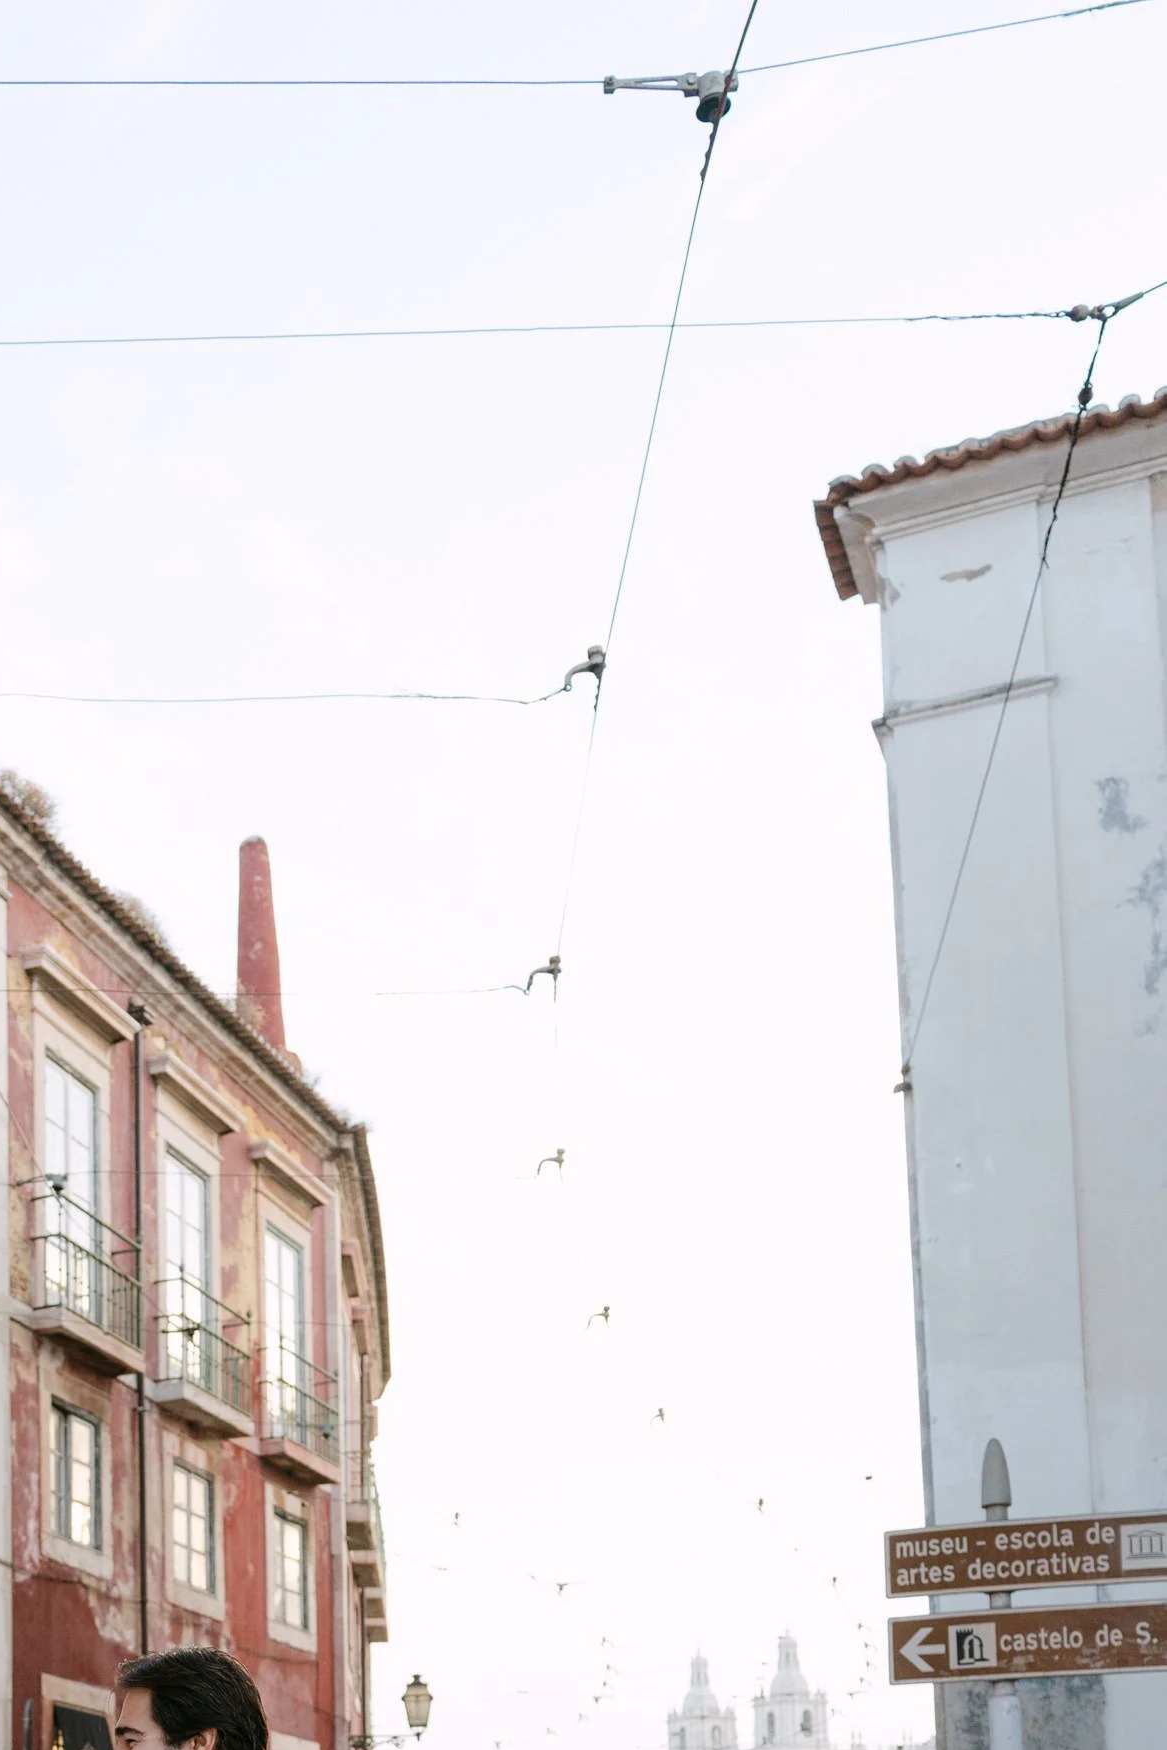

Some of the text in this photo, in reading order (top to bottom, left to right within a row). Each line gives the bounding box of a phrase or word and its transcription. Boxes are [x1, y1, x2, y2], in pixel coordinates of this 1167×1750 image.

[895, 1535, 969, 1559] museu
[994, 1523, 1075, 1551] escola
[1086, 1522, 1115, 1546] de
[895, 1552, 1110, 1587] artes decorativas
[999, 1621, 1160, 1653] castelo de S.
